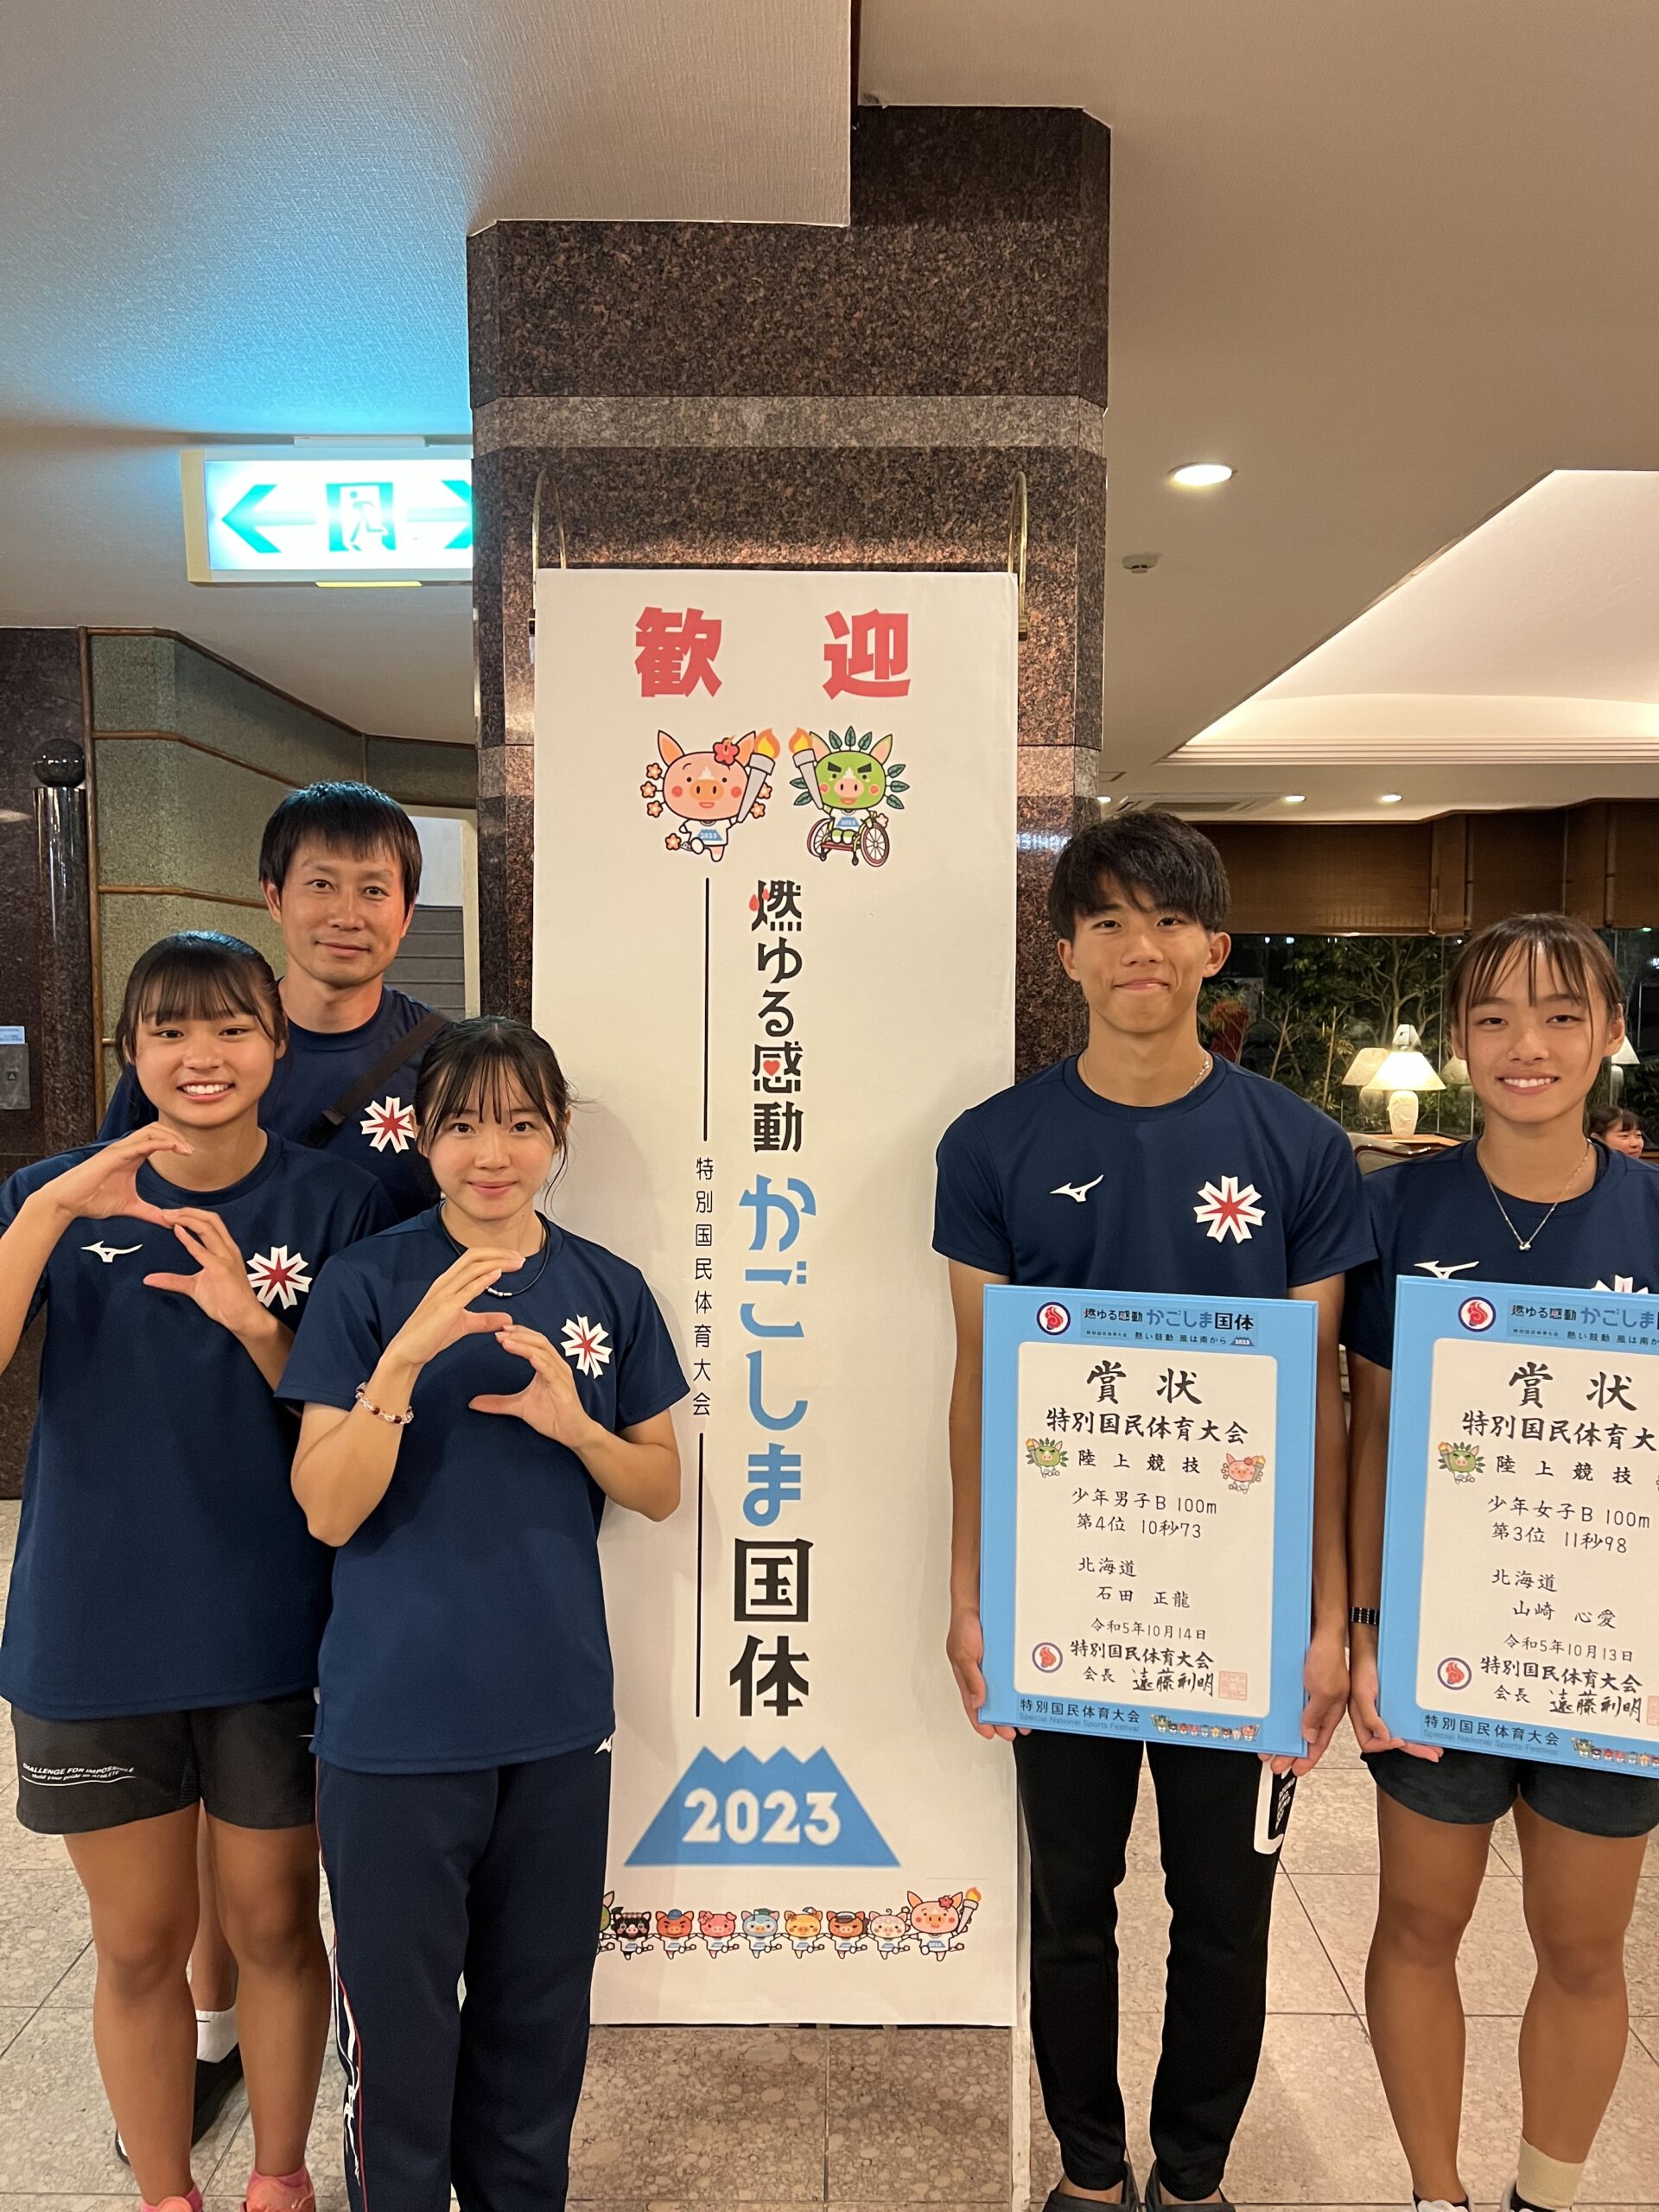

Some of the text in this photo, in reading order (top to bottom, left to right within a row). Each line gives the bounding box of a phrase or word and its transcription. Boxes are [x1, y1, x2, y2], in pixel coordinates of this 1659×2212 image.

[634, 607, 911, 700] 歓迎
[693, 1157, 714, 1416] 特別国民体育大会
[1087, 1360, 1202, 1405] 賞状
[1510, 1361, 1637, 1411] 賞状
[1046, 1408, 1249, 1445] 特別国民体育大会
[1462, 1410, 1657, 1452] 特別国民体育大
[1078, 1449, 1200, 1474] 陸上競技
[1497, 1455, 1633, 1484] 陸上競技
[1071, 1487, 1217, 1515] 少年男子B 100m
[1488, 1495, 1650, 1529] 少年女子B 100m
[1077, 1513, 1201, 1539] 第4位 10秒73
[1492, 1522, 1627, 1554] 第3位 11秒98
[1077, 1557, 1137, 1577] 北海道
[1491, 1568, 1557, 1592] 北海道
[1096, 1586, 1190, 1608] 石田 正龍
[1513, 1600, 1616, 1629] 山崎 心愛
[1090, 1618, 1206, 1641] 令和5年10月14日
[1070, 1639, 1214, 1669] 特別国民体育大会
[1503, 1633, 1633, 1662] 令和5年10月13日
[1082, 1666, 1116, 1683] 会長
[1480, 1656, 1643, 1694] 特別国民体育大会
[1493, 1685, 1530, 1703] 会長
[1020, 1698, 1140, 1723] 特別国民体育大会
[1020, 1713, 1140, 1732] Special National Sports Festival
[1424, 1713, 1560, 1745] 特別国民体育大会
[1424, 1729, 1455, 1742] Special
[1457, 1734, 1492, 1746] National
[1494, 1738, 1522, 1751] Sports
[23, 1763, 65, 1775] CHALLENGE
[682, 1789, 841, 1847] 2023
